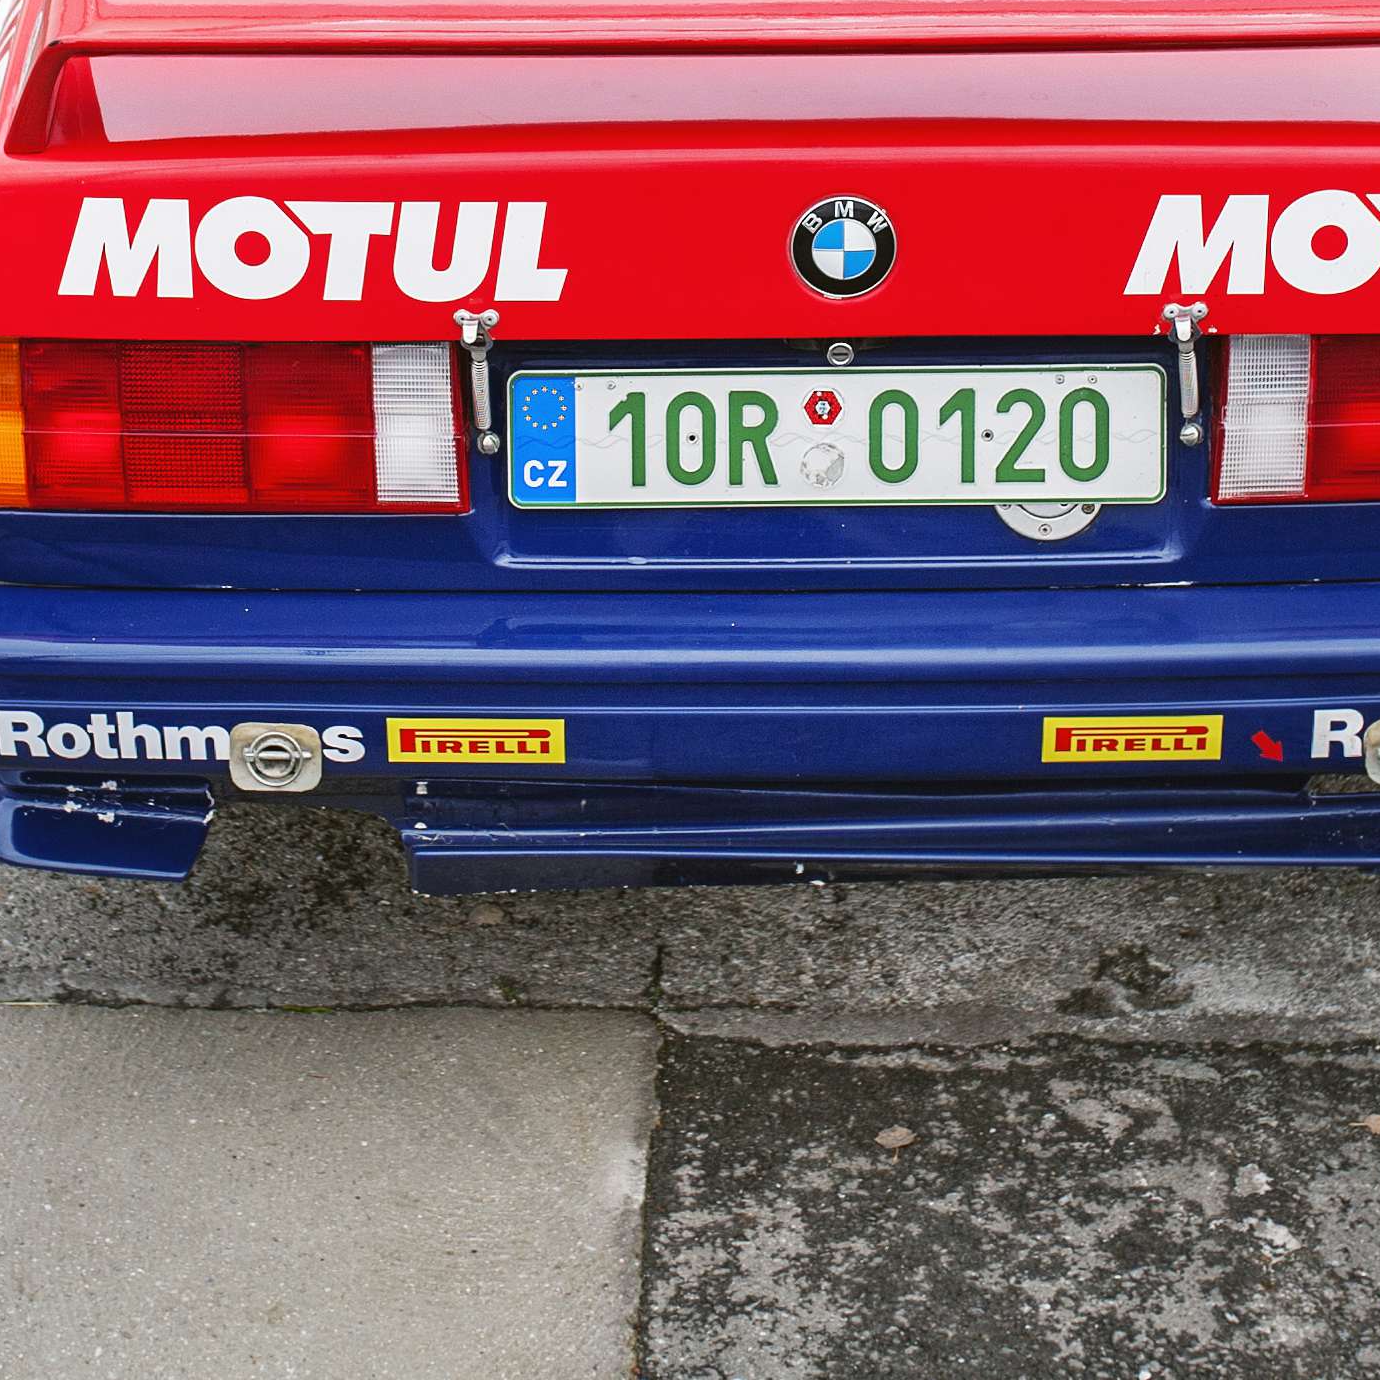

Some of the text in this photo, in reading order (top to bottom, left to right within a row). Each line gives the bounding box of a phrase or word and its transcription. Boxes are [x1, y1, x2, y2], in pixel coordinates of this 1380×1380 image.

[802, 200, 889, 234] BMW
[58, 196, 569, 302] MOTUL
[608, 388, 1112, 488] 10R 0120
[523, 460, 569, 488] CZ
[400, 728, 552, 754] PIRELLI
[1055, 726, 1209, 752] PIRELLI
